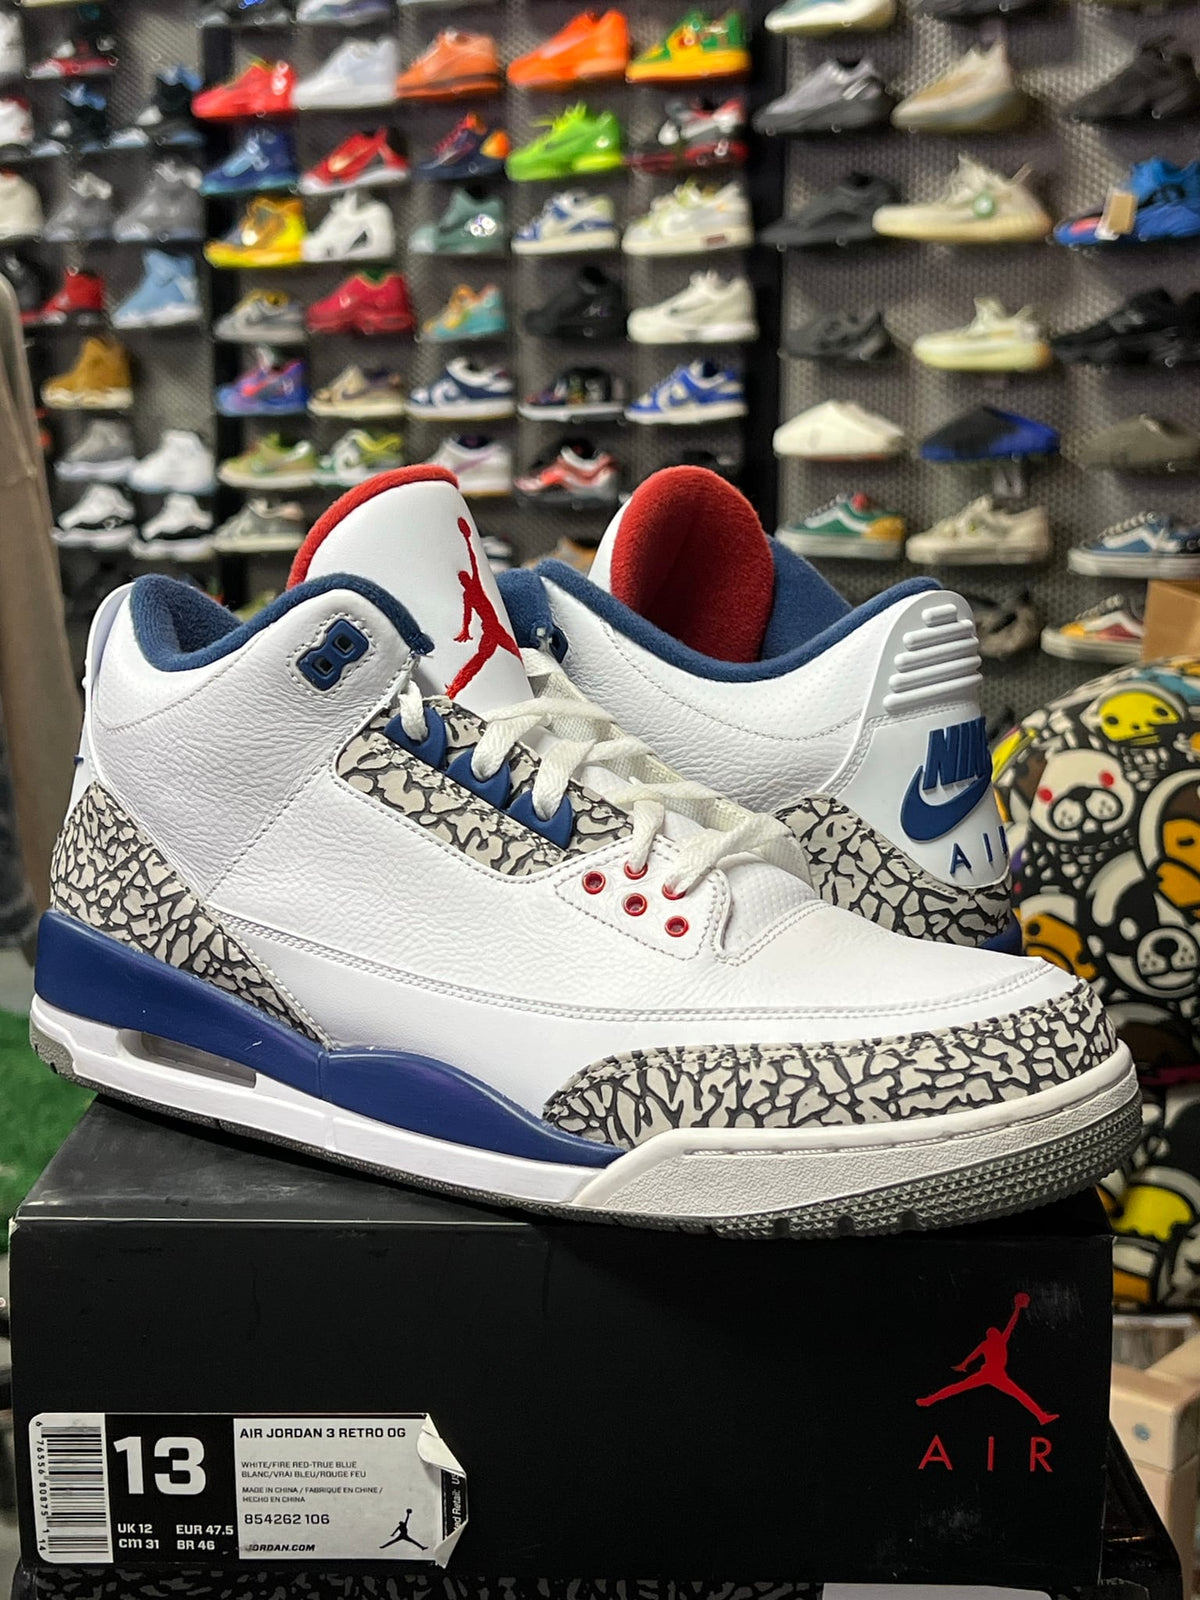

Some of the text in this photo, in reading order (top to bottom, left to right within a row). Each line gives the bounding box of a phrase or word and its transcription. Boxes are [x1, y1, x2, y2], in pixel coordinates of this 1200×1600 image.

[240, 1428, 406, 1438] AIR JORDAN 3 RETRO OG
[36, 1440, 45, 1475] 76556
[918, 1434, 1053, 1472] AIR
[113, 1436, 206, 1495] 13
[241, 1461, 291, 1469] WHITE/FIRE
[39, 1482, 49, 1516] 80875
[244, 1514, 330, 1524] 854262 106
[117, 1523, 153, 1534] UK 12
[176, 1525, 234, 1535] EUR 47.5
[145, 1539, 159, 1549] 31
[177, 1540, 215, 1550] BR 46
